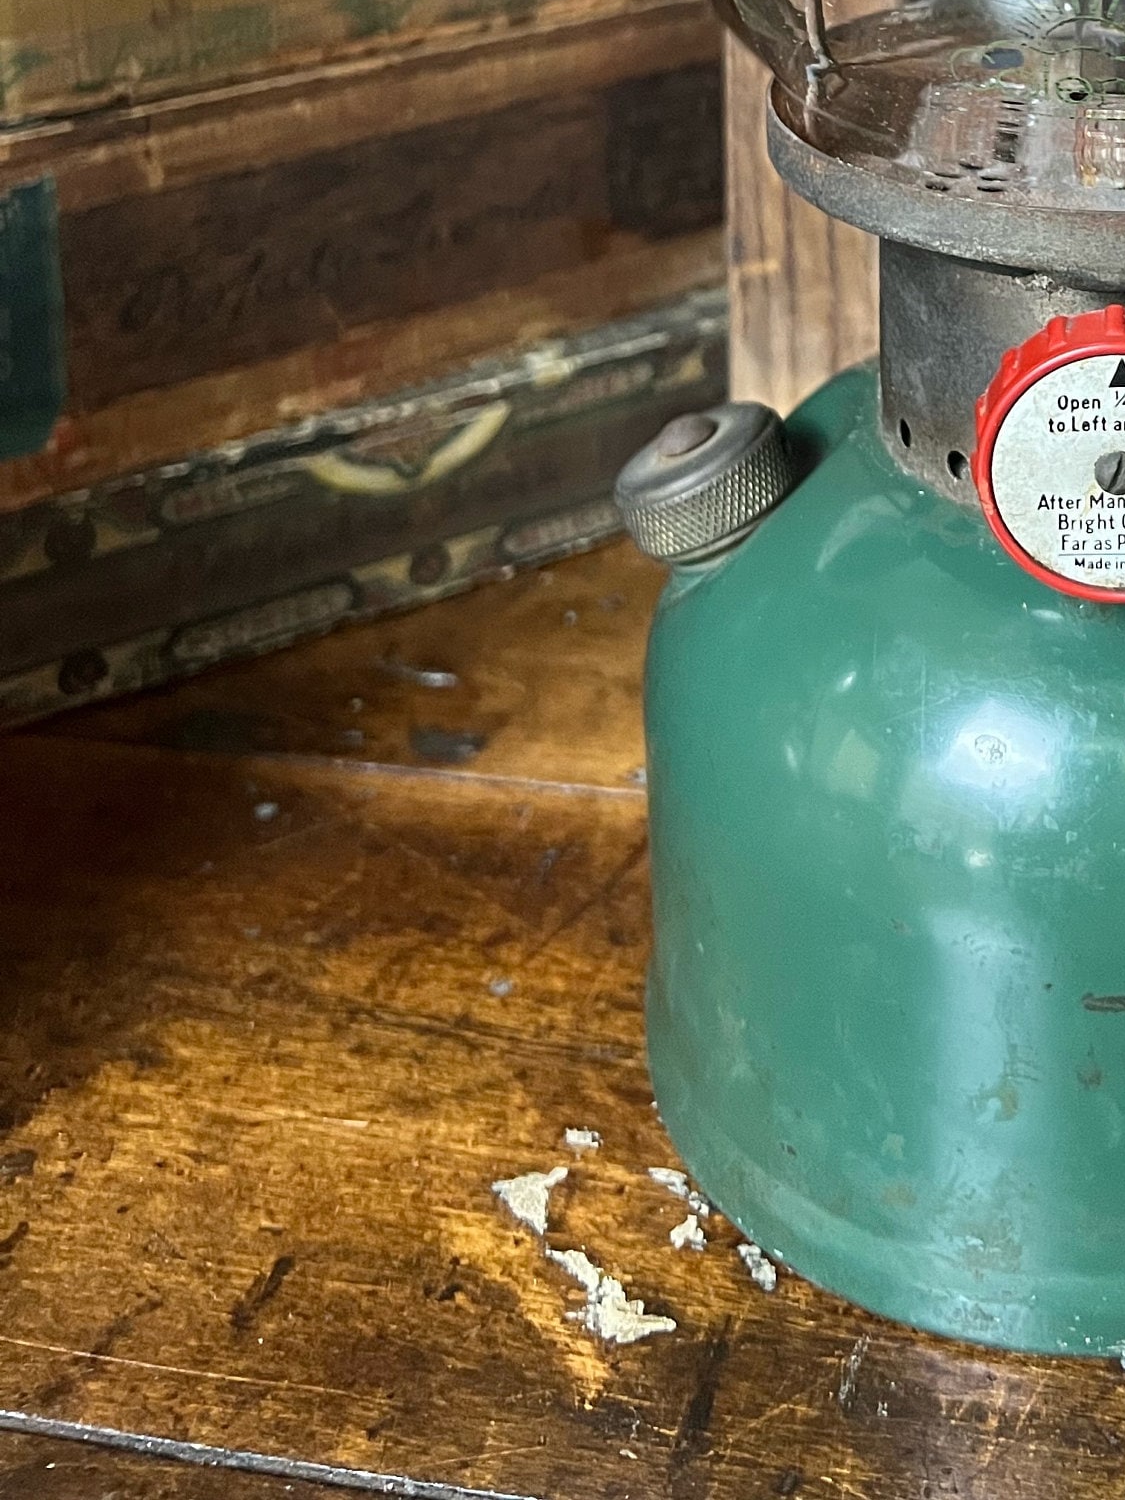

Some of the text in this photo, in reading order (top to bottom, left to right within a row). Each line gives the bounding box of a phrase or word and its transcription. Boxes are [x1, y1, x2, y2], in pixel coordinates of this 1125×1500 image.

[1057, 394, 1101, 413] Open
[1048, 417, 1067, 433] to
[1071, 416, 1107, 432] Left
[1037, 493, 1082, 510] After
[1058, 513, 1115, 533] Bright
[1062, 535, 1088, 550] Far
[1093, 537, 1112, 550] as
[1074, 557, 1112, 570] Made
